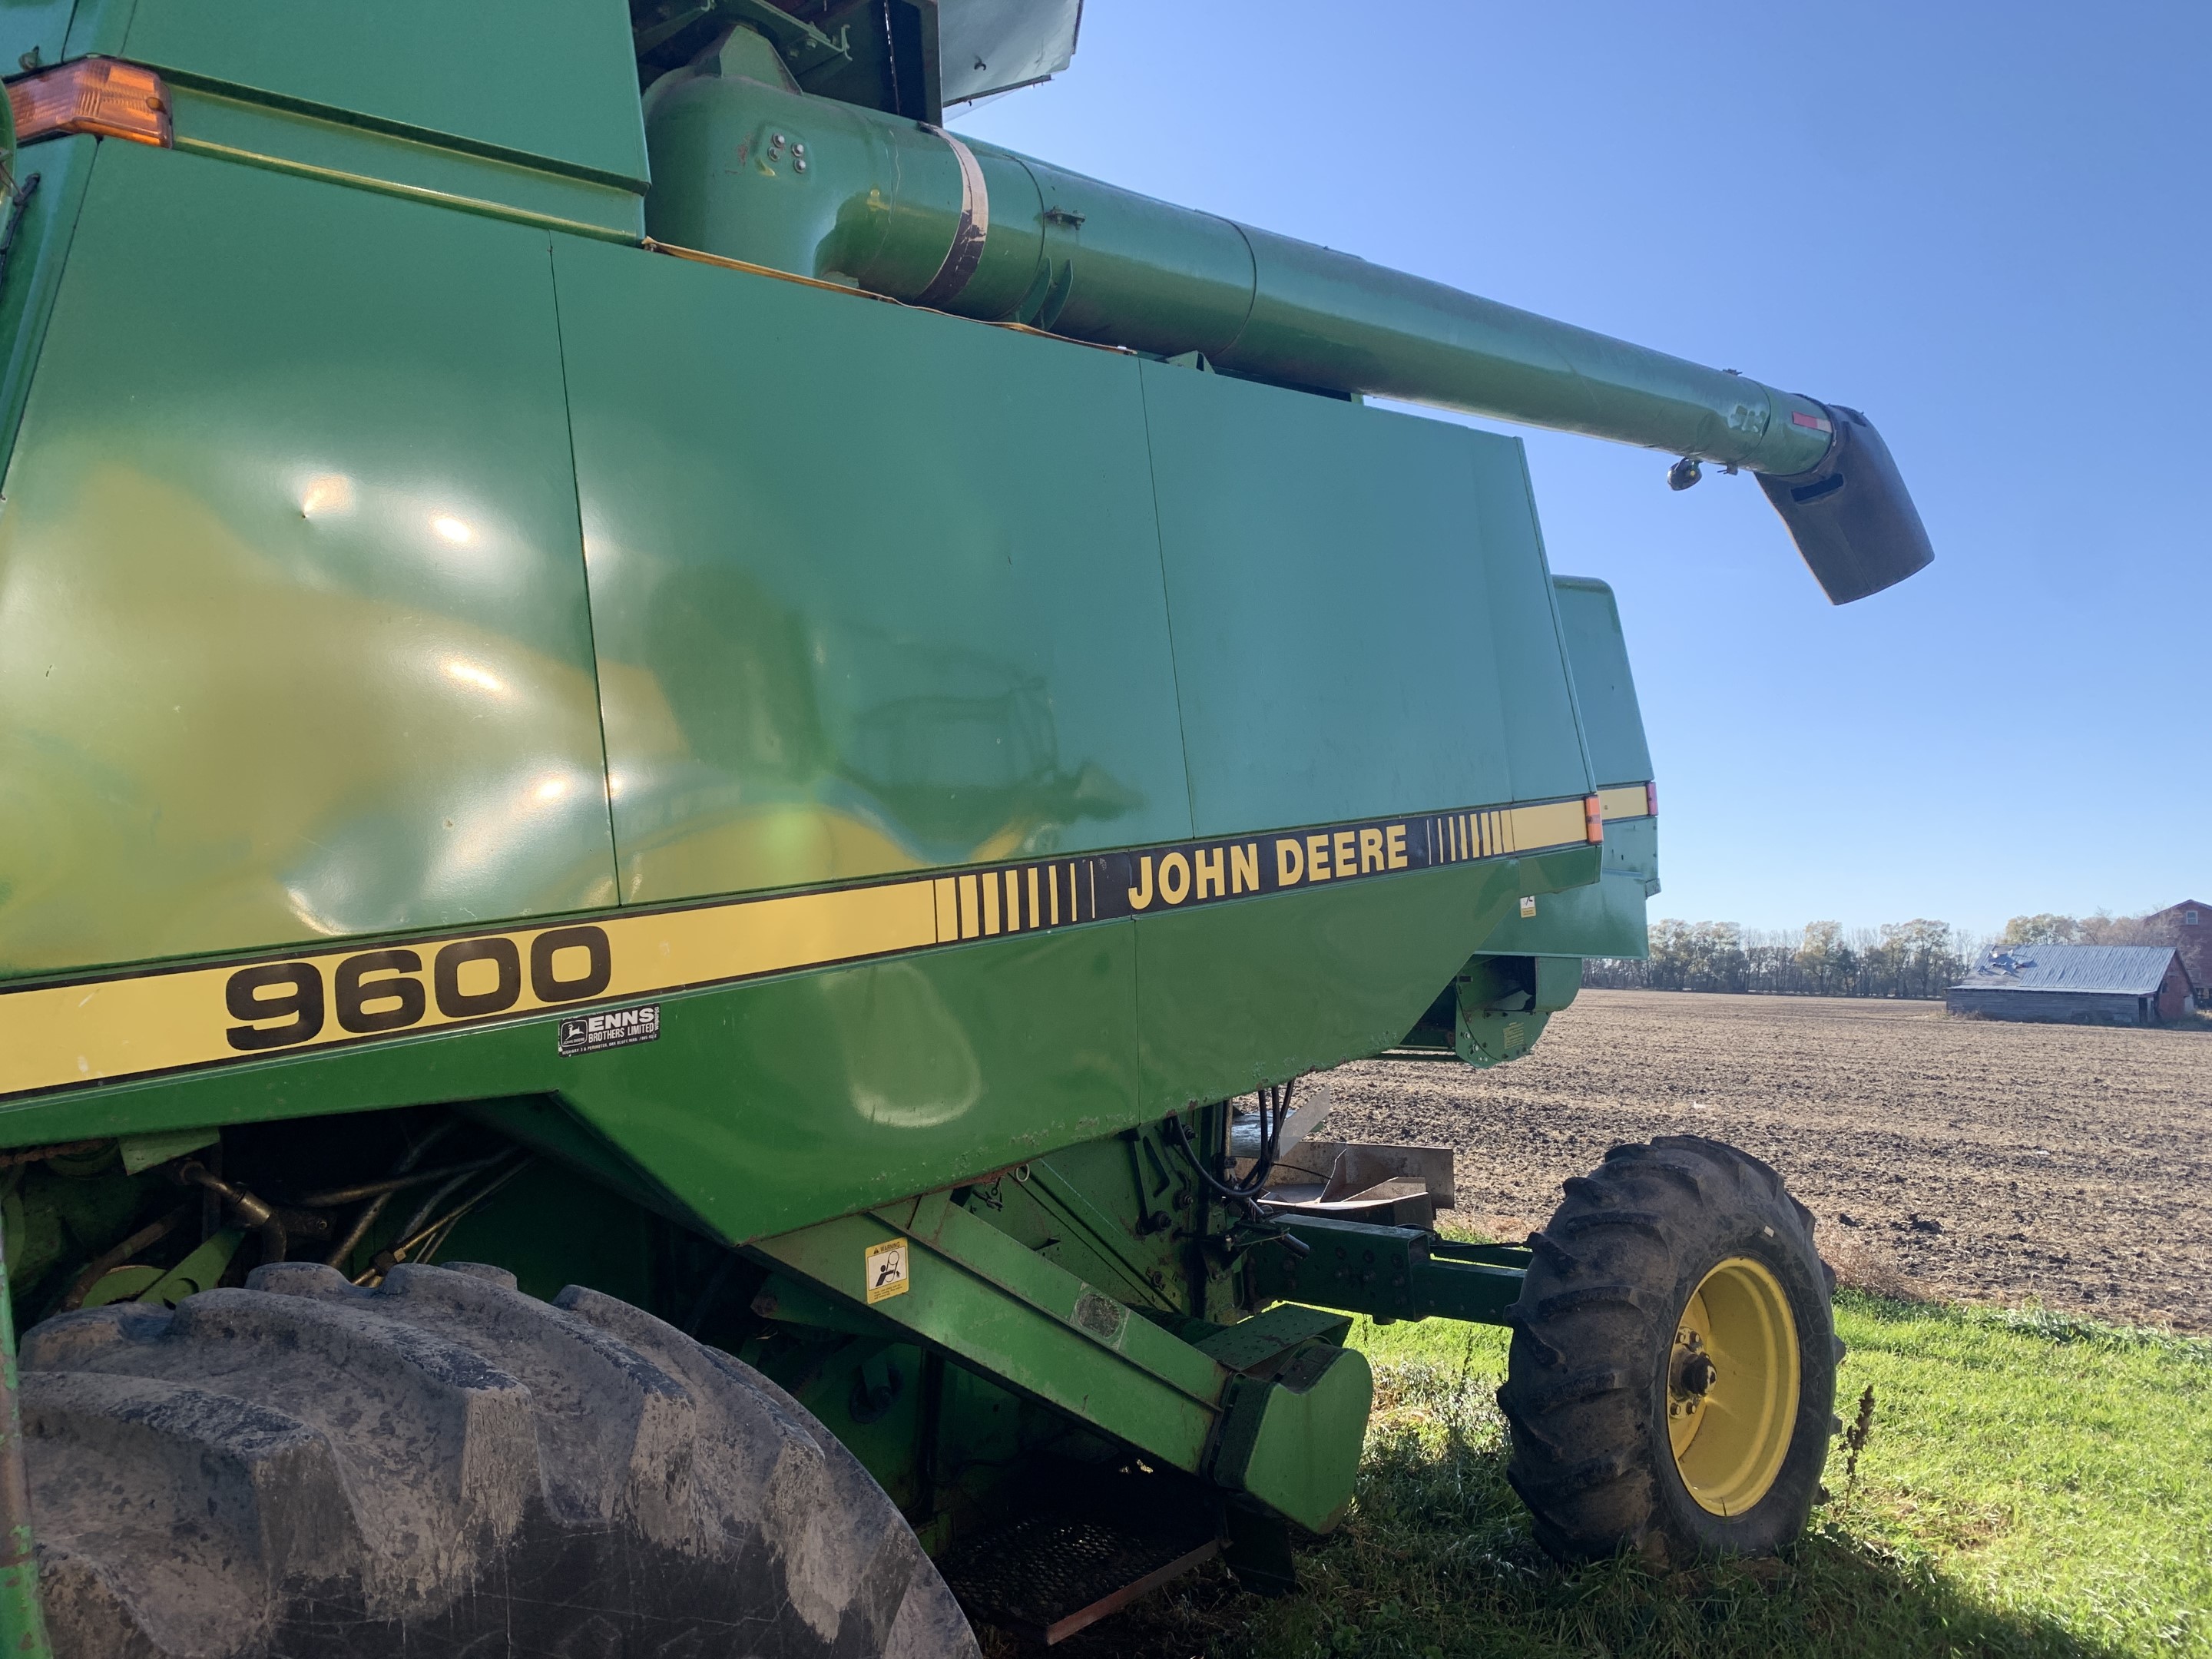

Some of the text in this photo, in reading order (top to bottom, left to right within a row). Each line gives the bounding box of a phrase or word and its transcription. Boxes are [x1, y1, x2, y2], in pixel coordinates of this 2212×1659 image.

[1128, 824, 1408, 909] JOHN DEERE
[225, 926, 612, 1051] 9600
[588, 1008, 654, 1032] ENNS
[588, 1028, 625, 1043] BROTHERS
[628, 1022, 654, 1036] LIMITED
